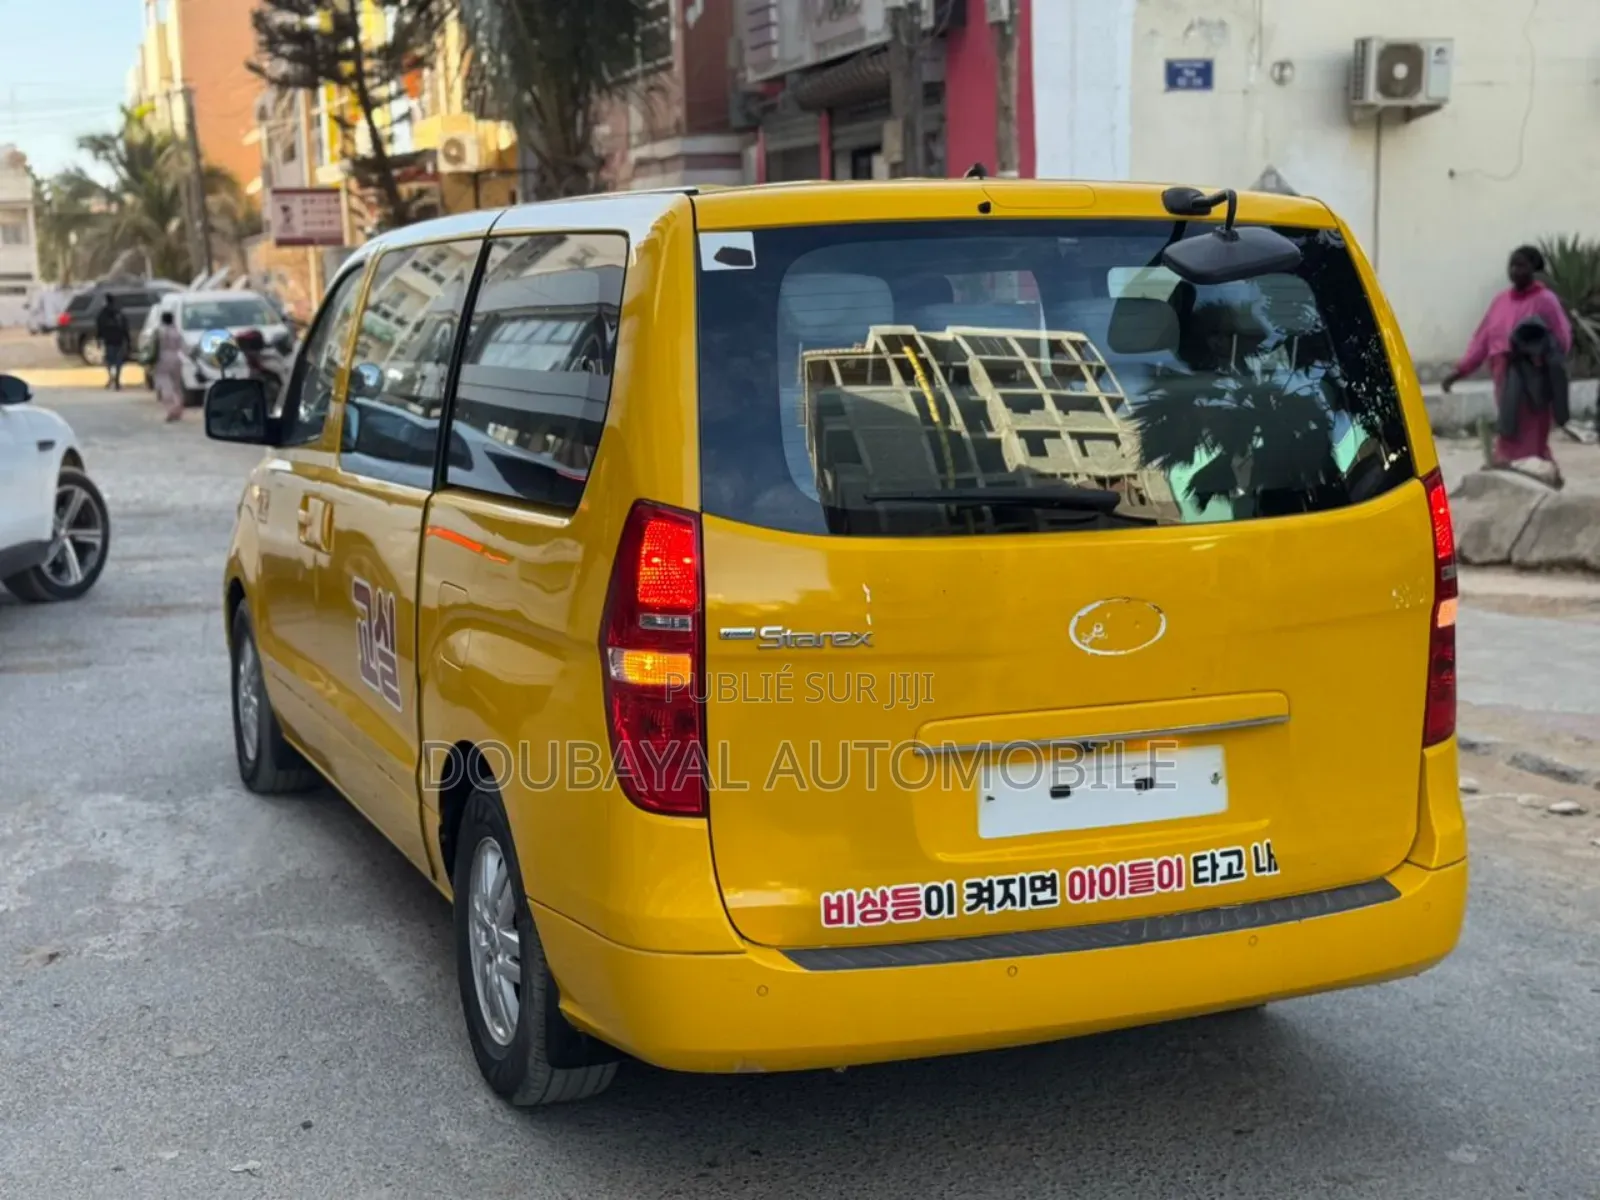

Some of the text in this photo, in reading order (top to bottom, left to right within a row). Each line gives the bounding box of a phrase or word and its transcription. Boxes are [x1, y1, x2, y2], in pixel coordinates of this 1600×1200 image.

[758, 625, 874, 649] Starex
[821, 881, 957, 928] 비상등이
[964, 871, 1059, 914] 켜지면
[1067, 855, 1186, 904] 아이들이
[1192, 847, 1246, 886] 타고
